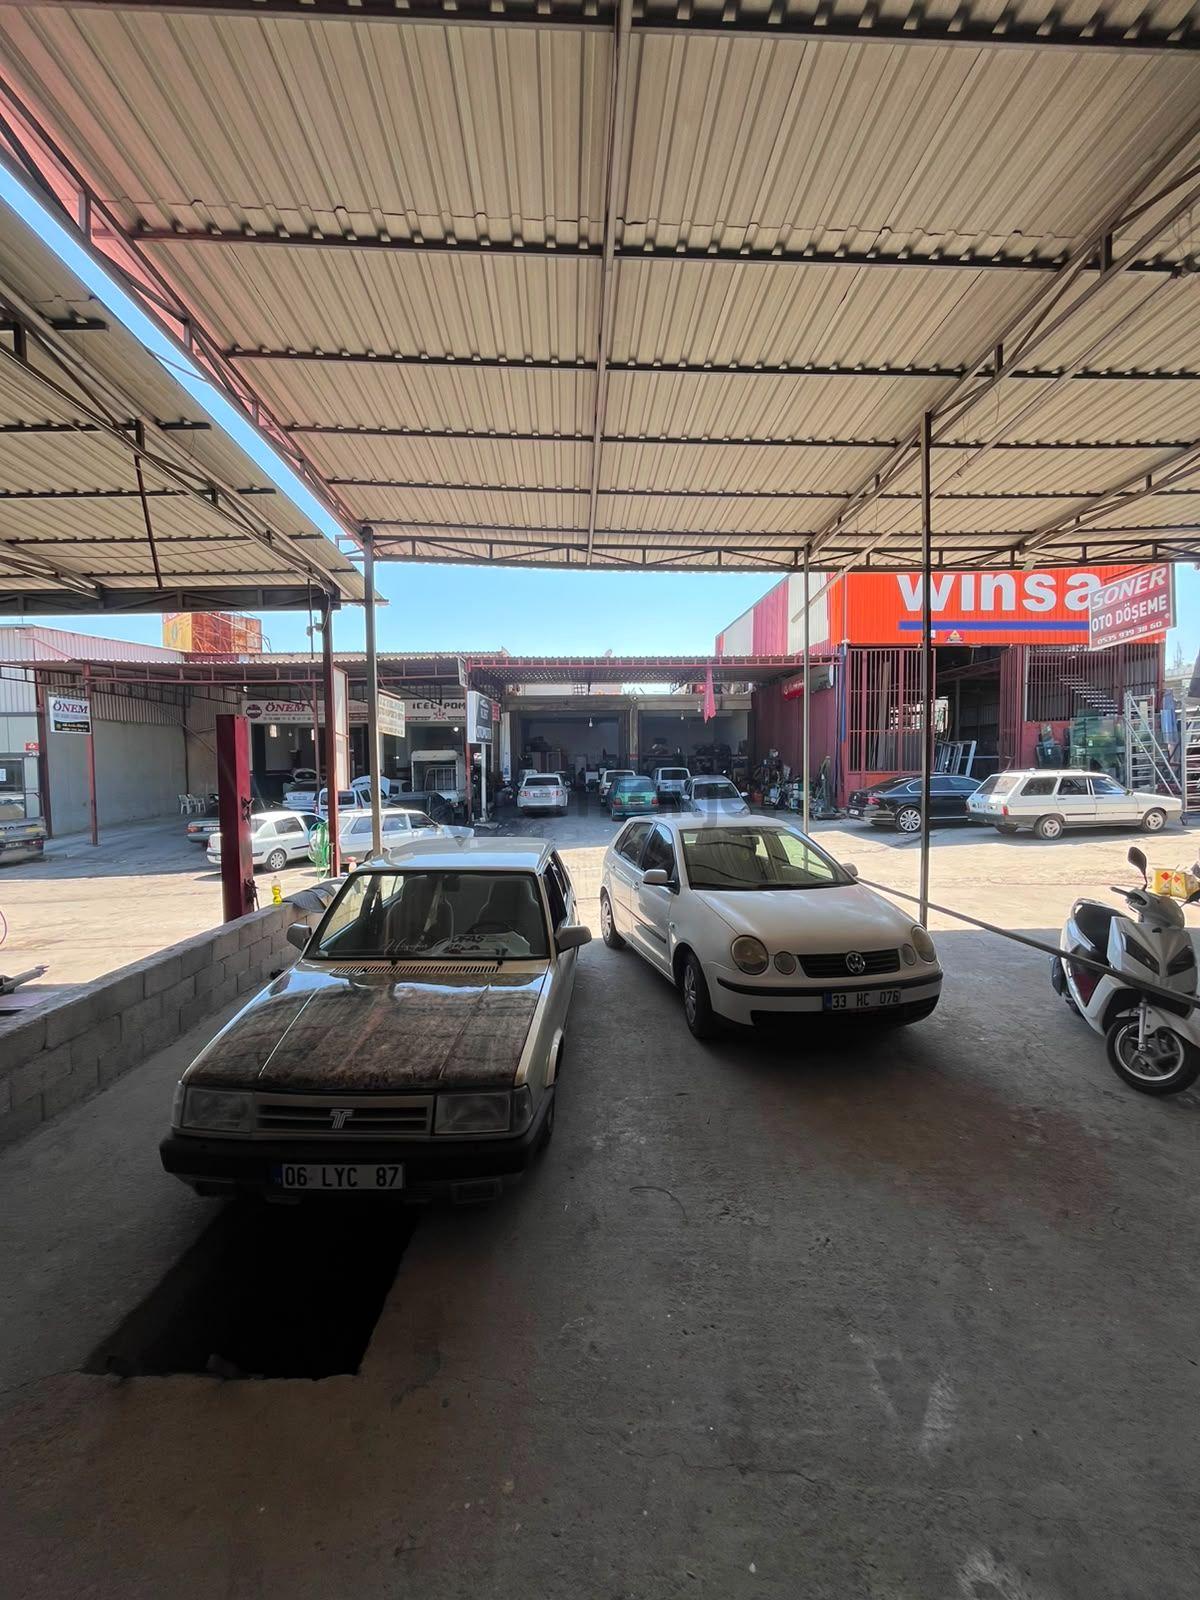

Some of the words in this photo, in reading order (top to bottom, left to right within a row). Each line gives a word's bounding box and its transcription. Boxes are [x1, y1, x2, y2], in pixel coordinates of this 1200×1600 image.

[896, 573, 1102, 612] winsa
[1091, 567, 1167, 610] SONER
[1092, 613, 1113, 632] OTO
[1116, 594, 1167, 623] DÖŞEME
[53, 700, 88, 713] ÖNEM
[265, 702, 306, 713] ÖNEM
[833, 994, 847, 1008] 33
[285, 1166, 308, 1187] 06
[322, 1167, 358, 1187] LYC
[376, 1167, 399, 1187] 87
